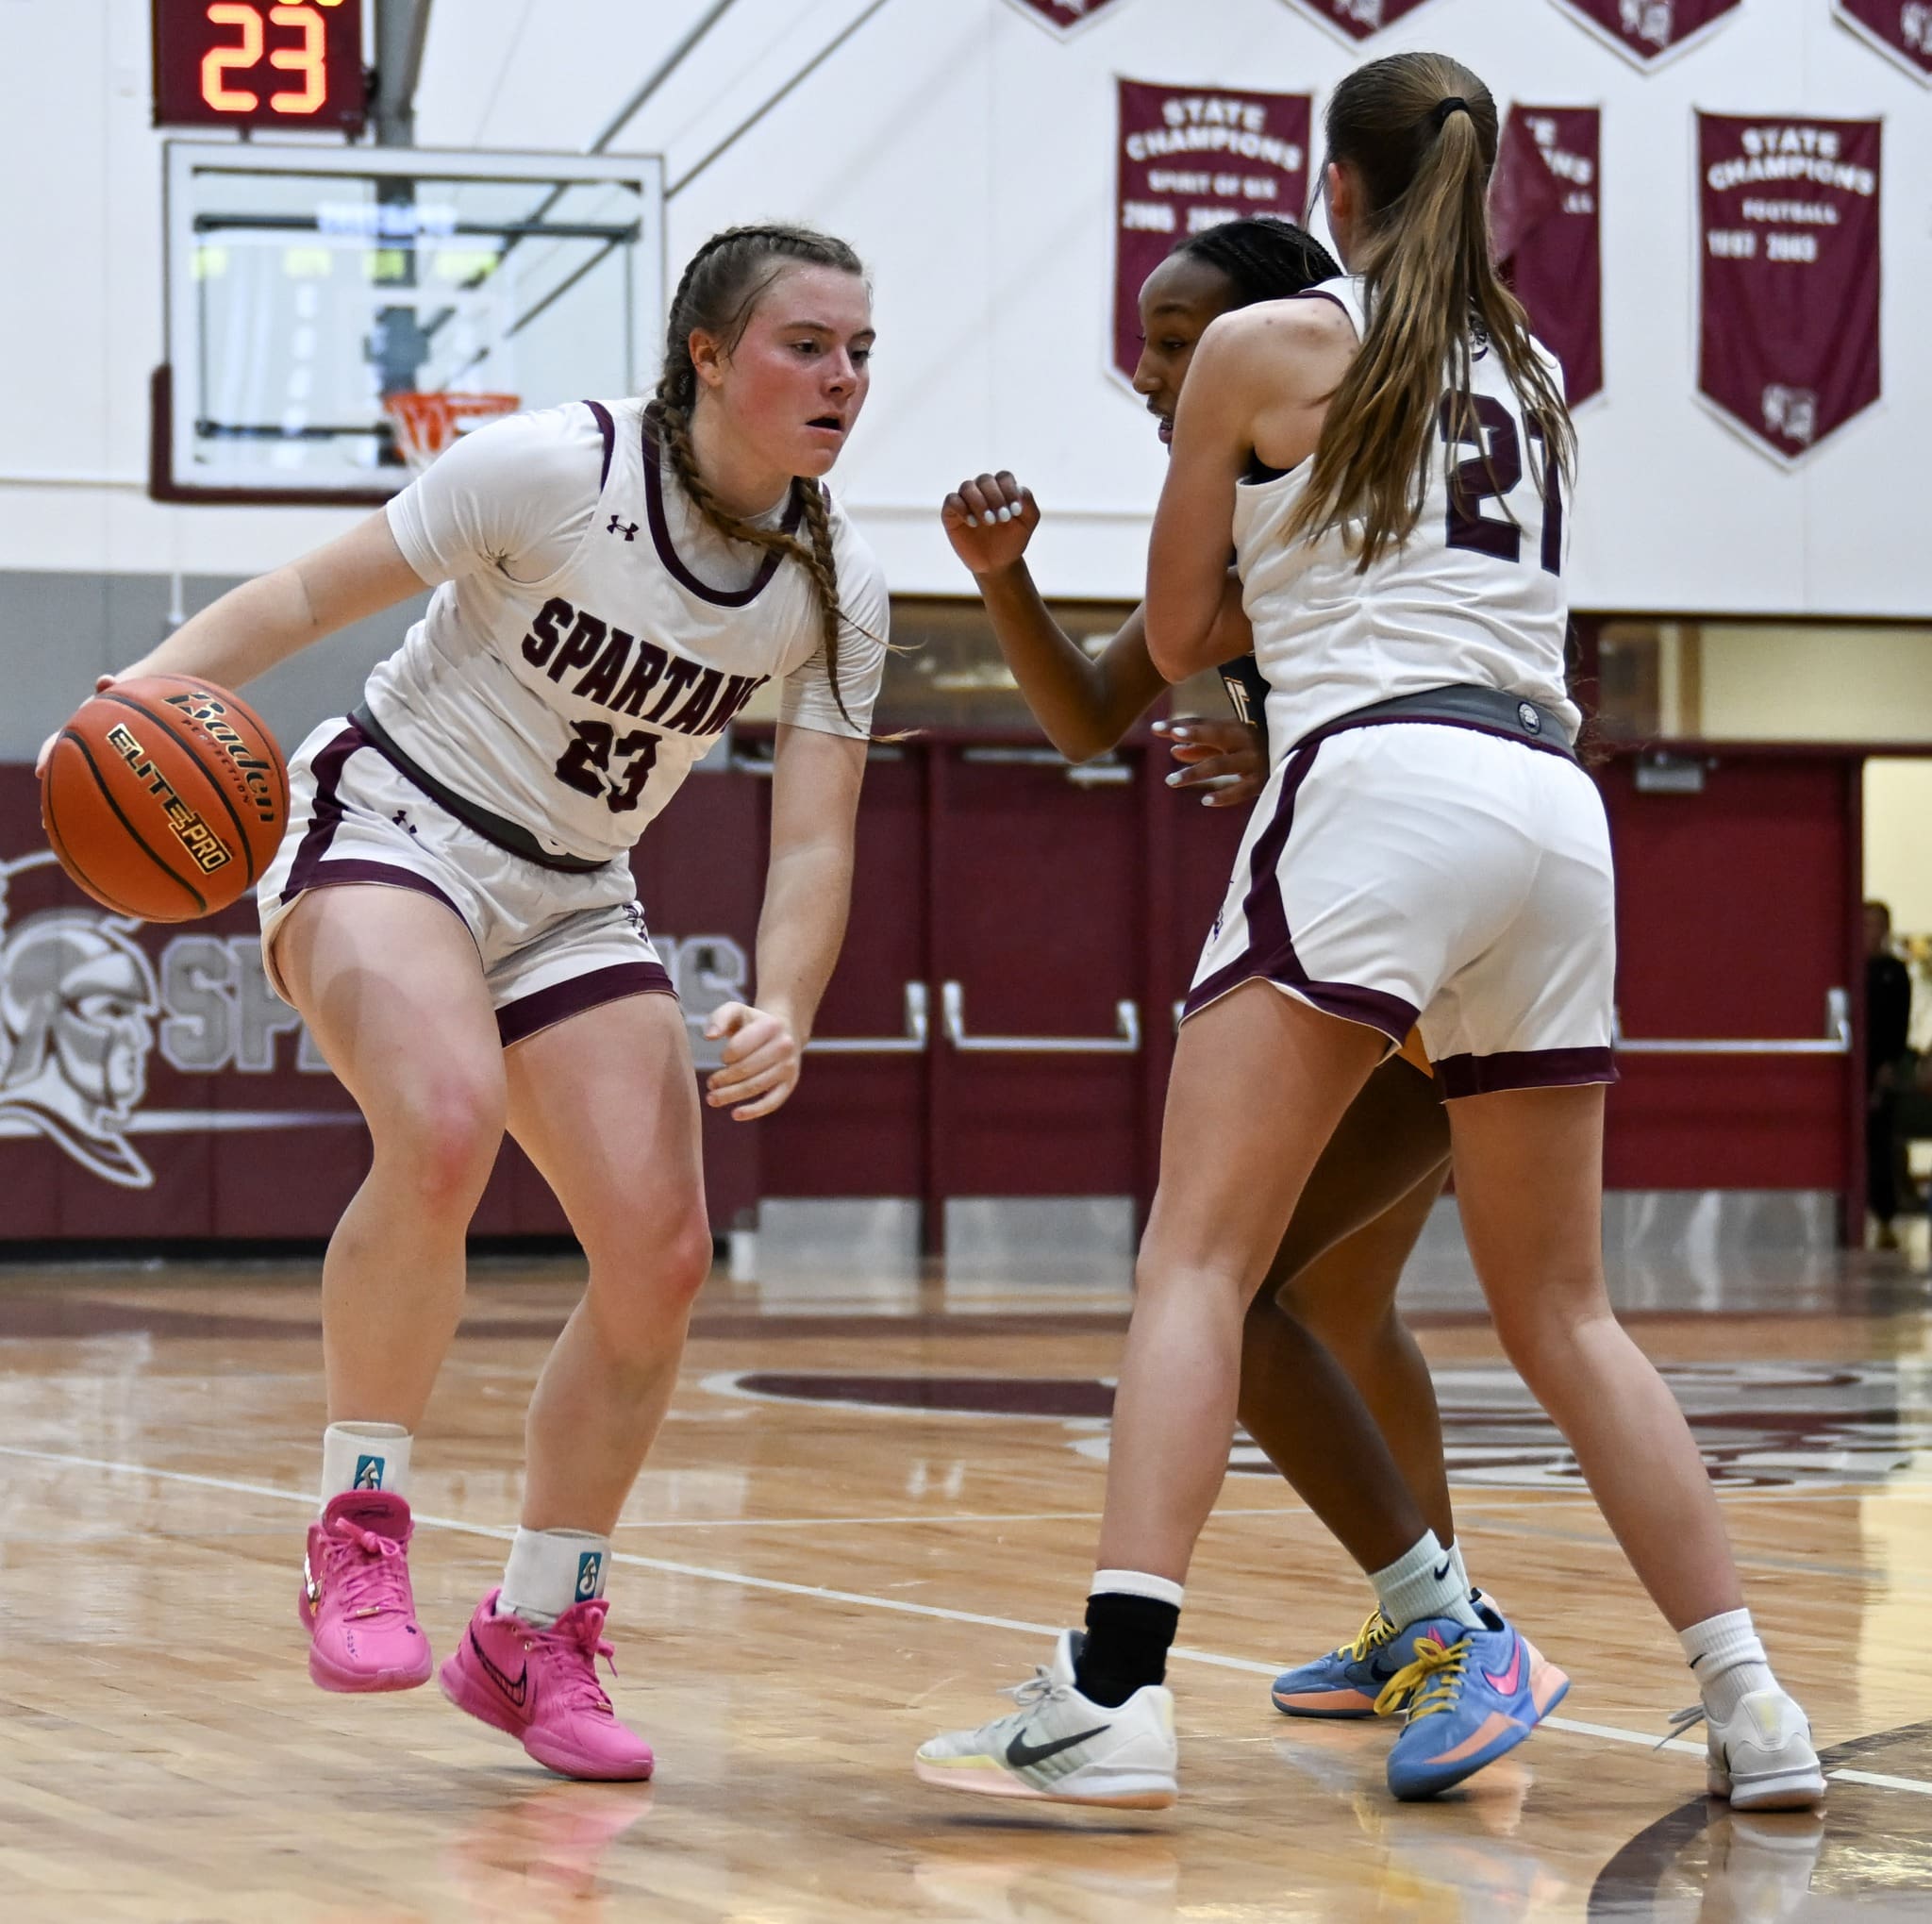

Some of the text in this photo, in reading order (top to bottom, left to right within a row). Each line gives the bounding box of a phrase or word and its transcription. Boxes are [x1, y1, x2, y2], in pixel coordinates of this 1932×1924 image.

[201, 4, 326, 113] 23
[1161, 97, 1267, 133] STATE
[1126, 125, 1304, 172] CHAMPIONS
[1741, 126, 1841, 159] STATE
[1707, 154, 1874, 195] CHAMPIONS
[1439, 387, 1564, 577] 21
[162, 692, 275, 823] Baden
[554, 719, 663, 813] 23
[179, 819, 229, 872] PRO
